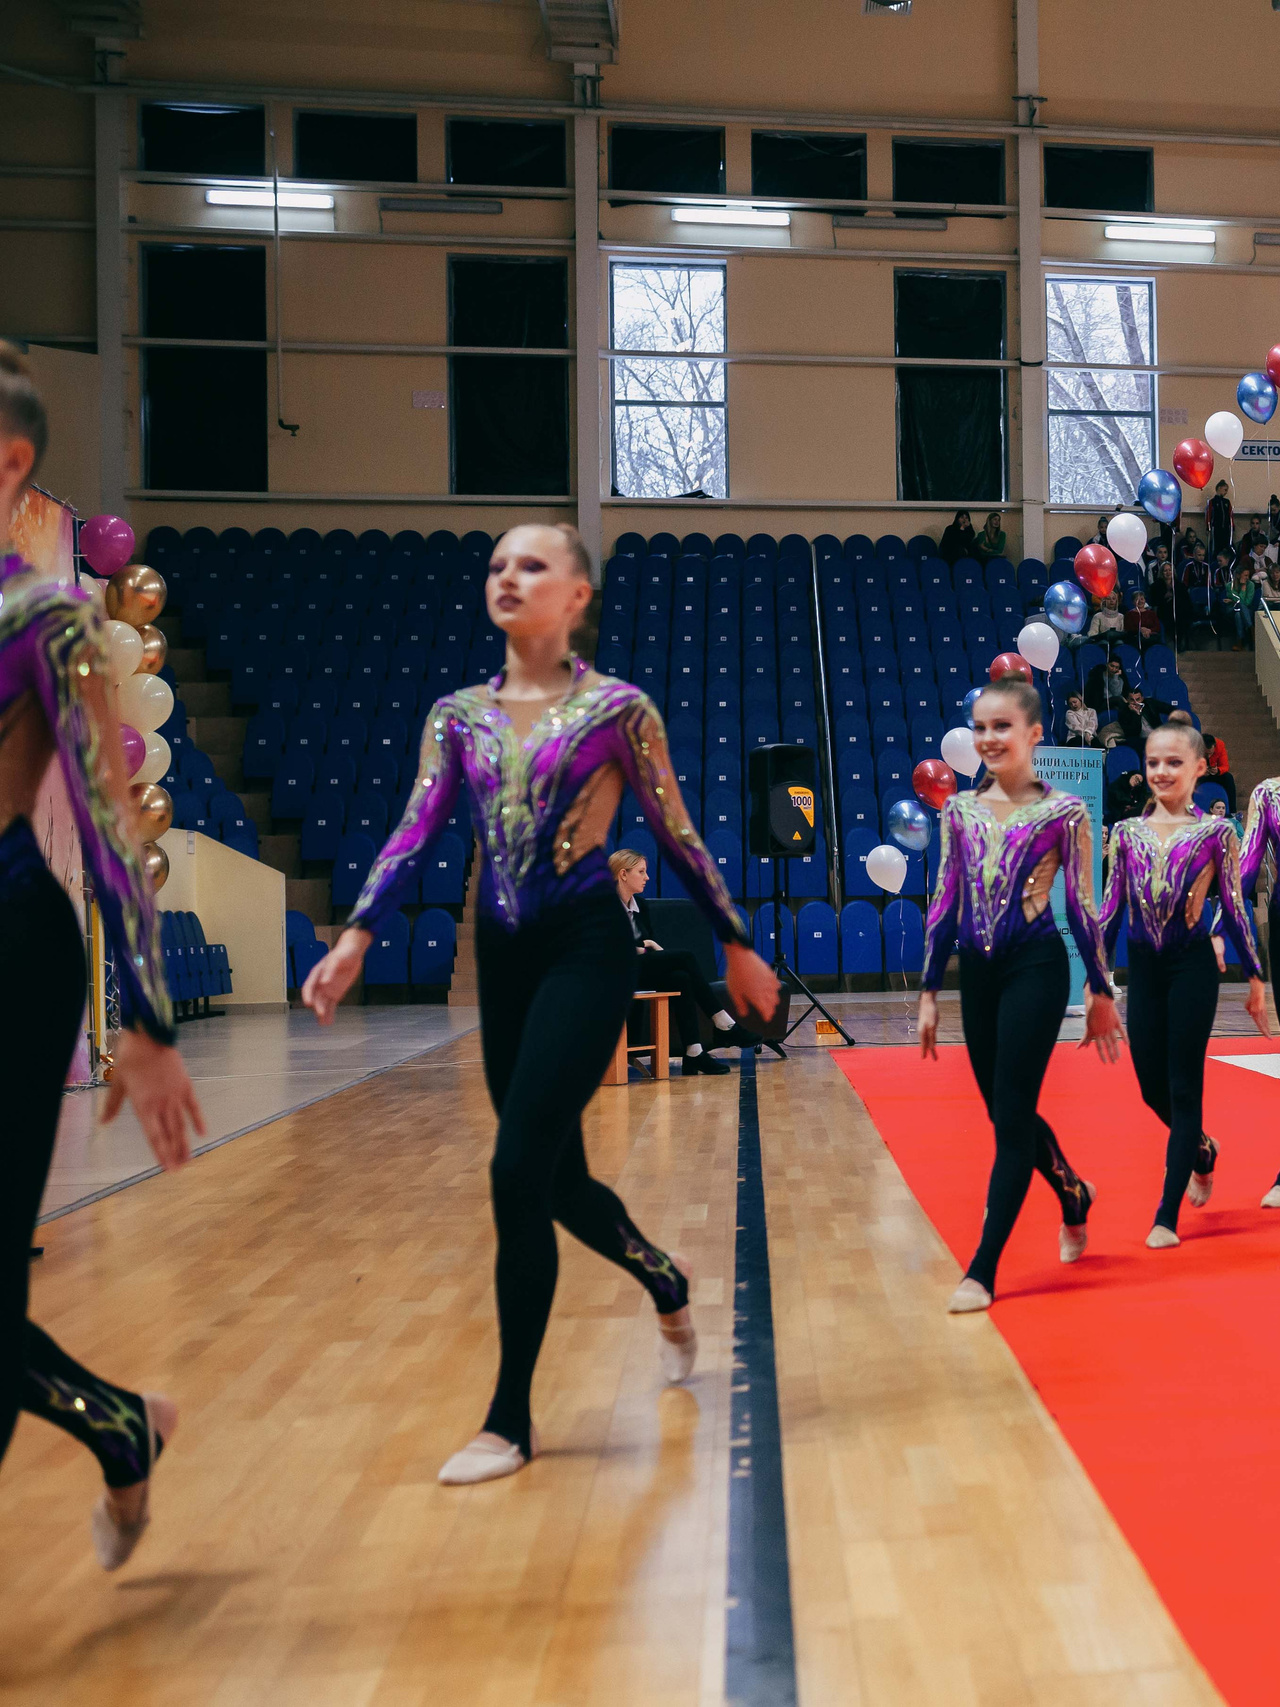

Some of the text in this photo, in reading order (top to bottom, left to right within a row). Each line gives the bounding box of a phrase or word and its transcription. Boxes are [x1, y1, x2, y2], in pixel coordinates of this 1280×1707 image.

[1032, 757, 1102, 769] ФИЦИАЛЬНЫЕ
[1036, 770, 1090, 781] ПАРТНЕРЫ
[792, 795, 812, 807] 1000
